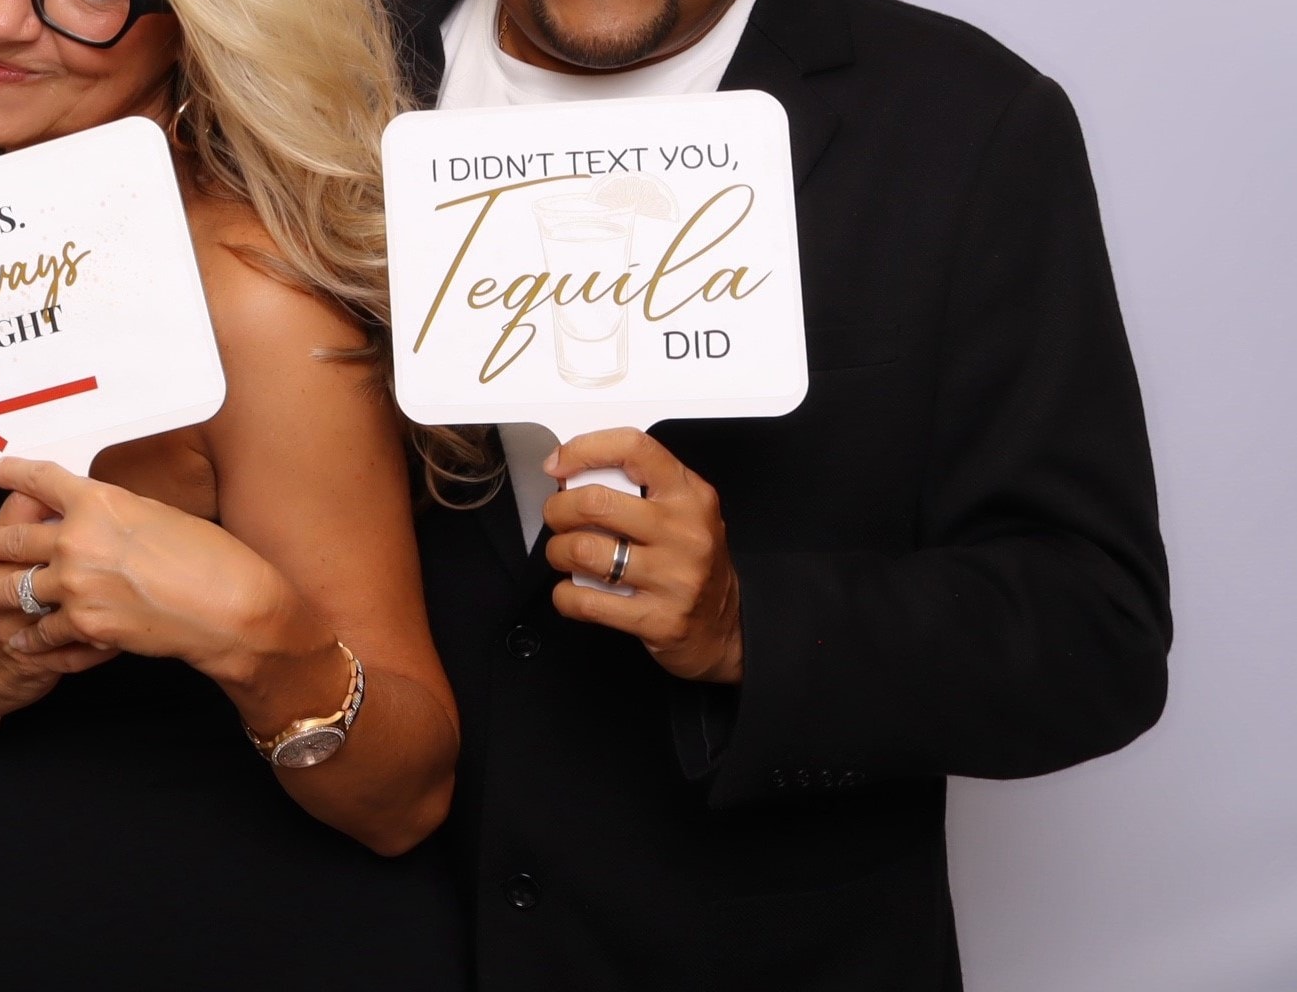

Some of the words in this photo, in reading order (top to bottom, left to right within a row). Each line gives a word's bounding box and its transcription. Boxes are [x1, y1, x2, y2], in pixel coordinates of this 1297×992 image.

[432, 159, 438, 182] I
[450, 152, 555, 181] DIDN'T
[565, 147, 649, 174] TEXT
[659, 143, 739, 171] YOU,
[412, 174, 773, 384] Tequila
[663, 330, 730, 360] DID
